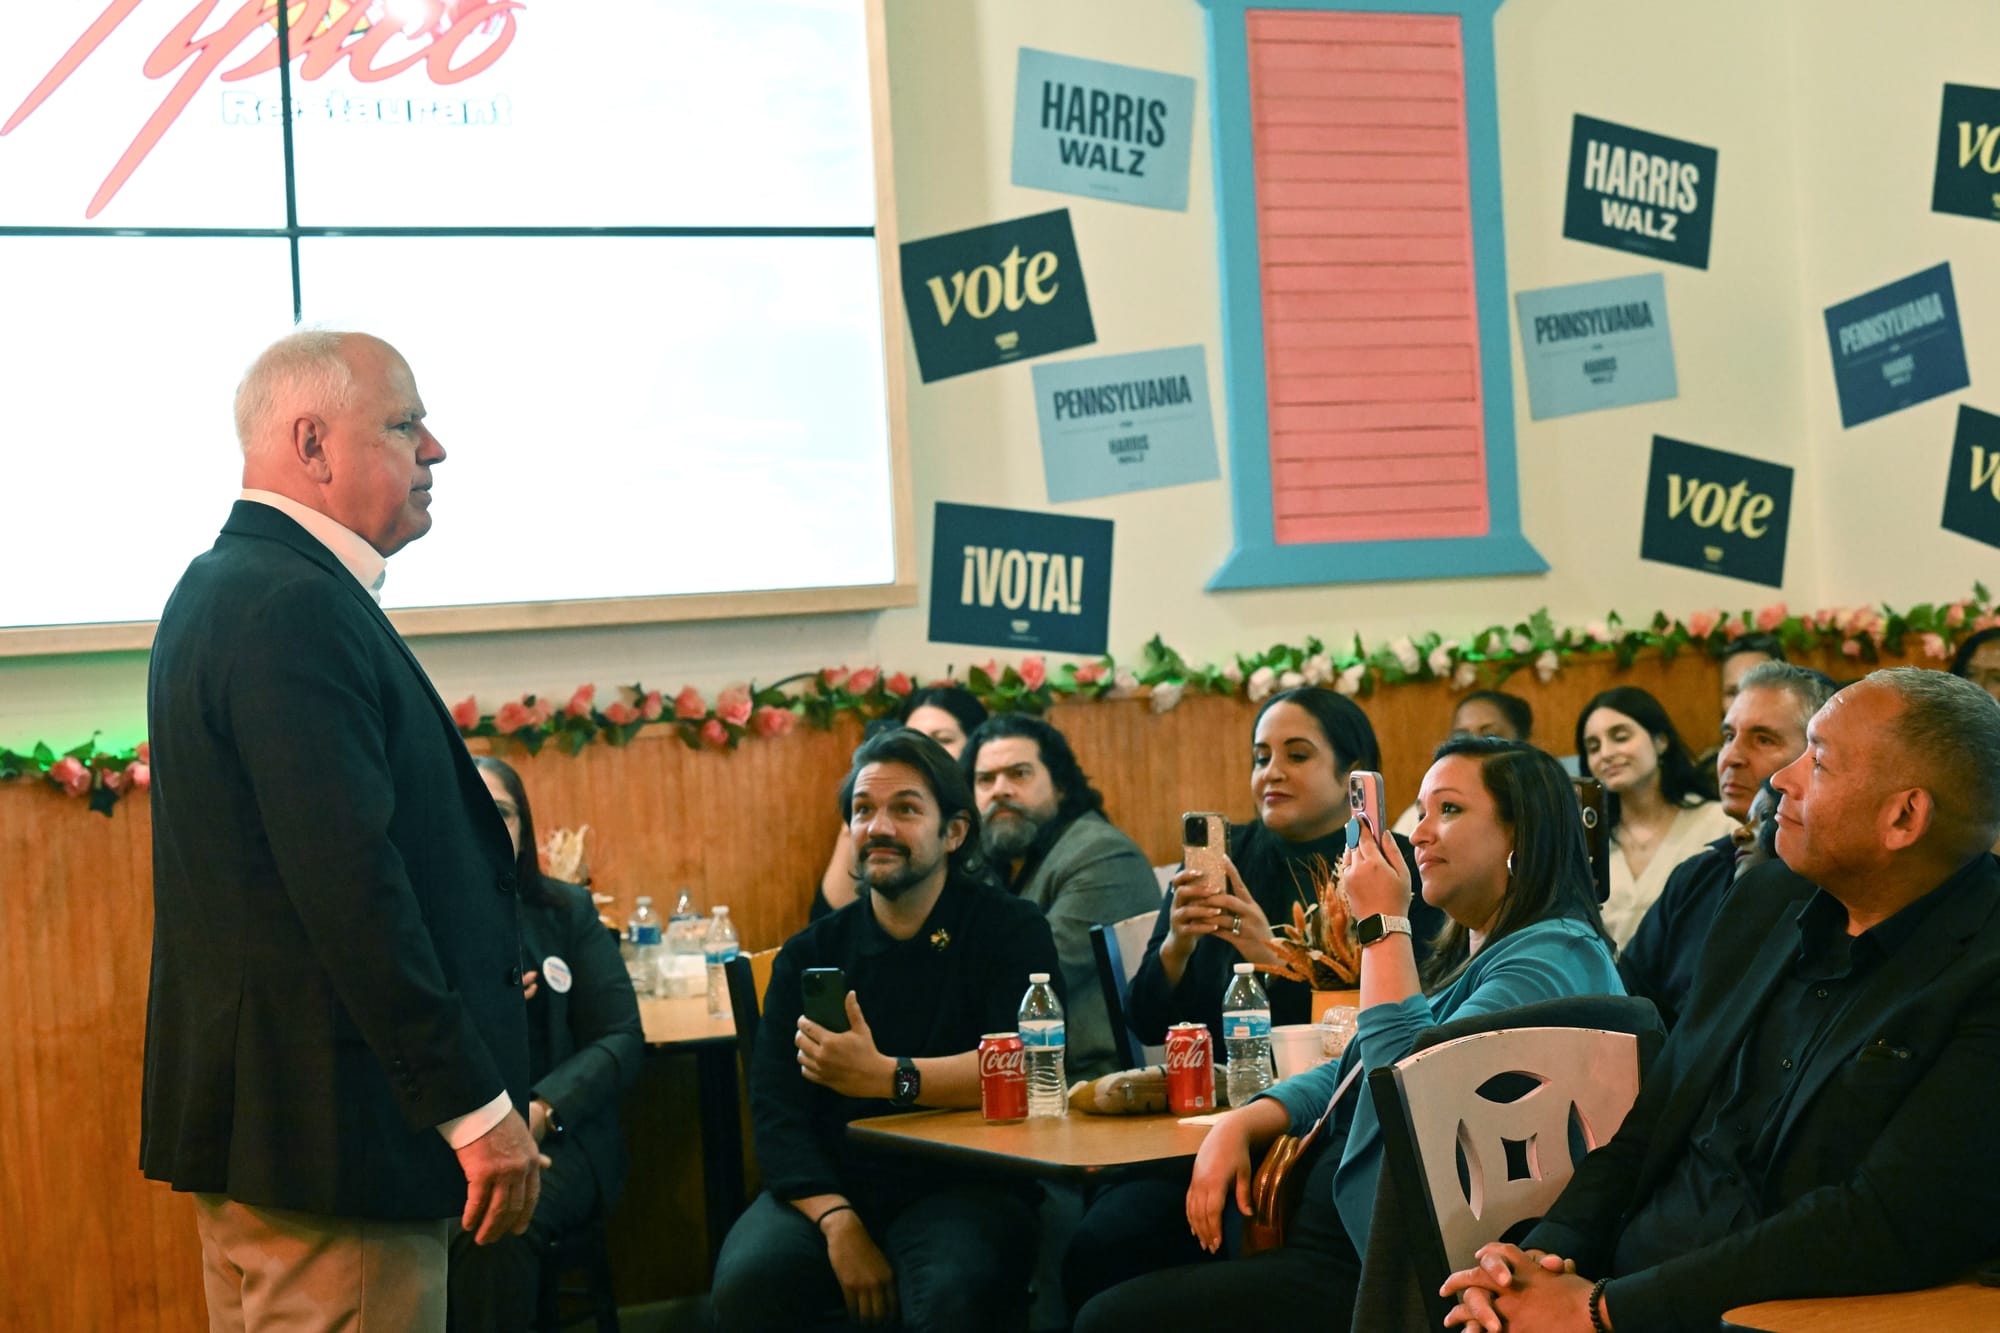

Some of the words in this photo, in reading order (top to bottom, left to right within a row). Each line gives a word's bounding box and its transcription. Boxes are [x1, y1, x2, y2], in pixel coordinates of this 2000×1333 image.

[222, 90, 512, 126] Restaurant
[1041, 80, 1167, 148] HARRIS
[1059, 137, 1146, 177] WALZ
[1584, 140, 1699, 214] HARRIS
[1601, 199, 1678, 241] WALZ
[926, 246, 1059, 326] vote
[1534, 301, 1654, 344] PENNSYLVANIA
[1053, 374, 1193, 421] PENNSYLVANIA
[1667, 474, 1775, 539] vote
[961, 545, 1084, 615] ¡VOTA!
[980, 1046, 1023, 1077] Coca
[1166, 1036, 1206, 1068] Cola
